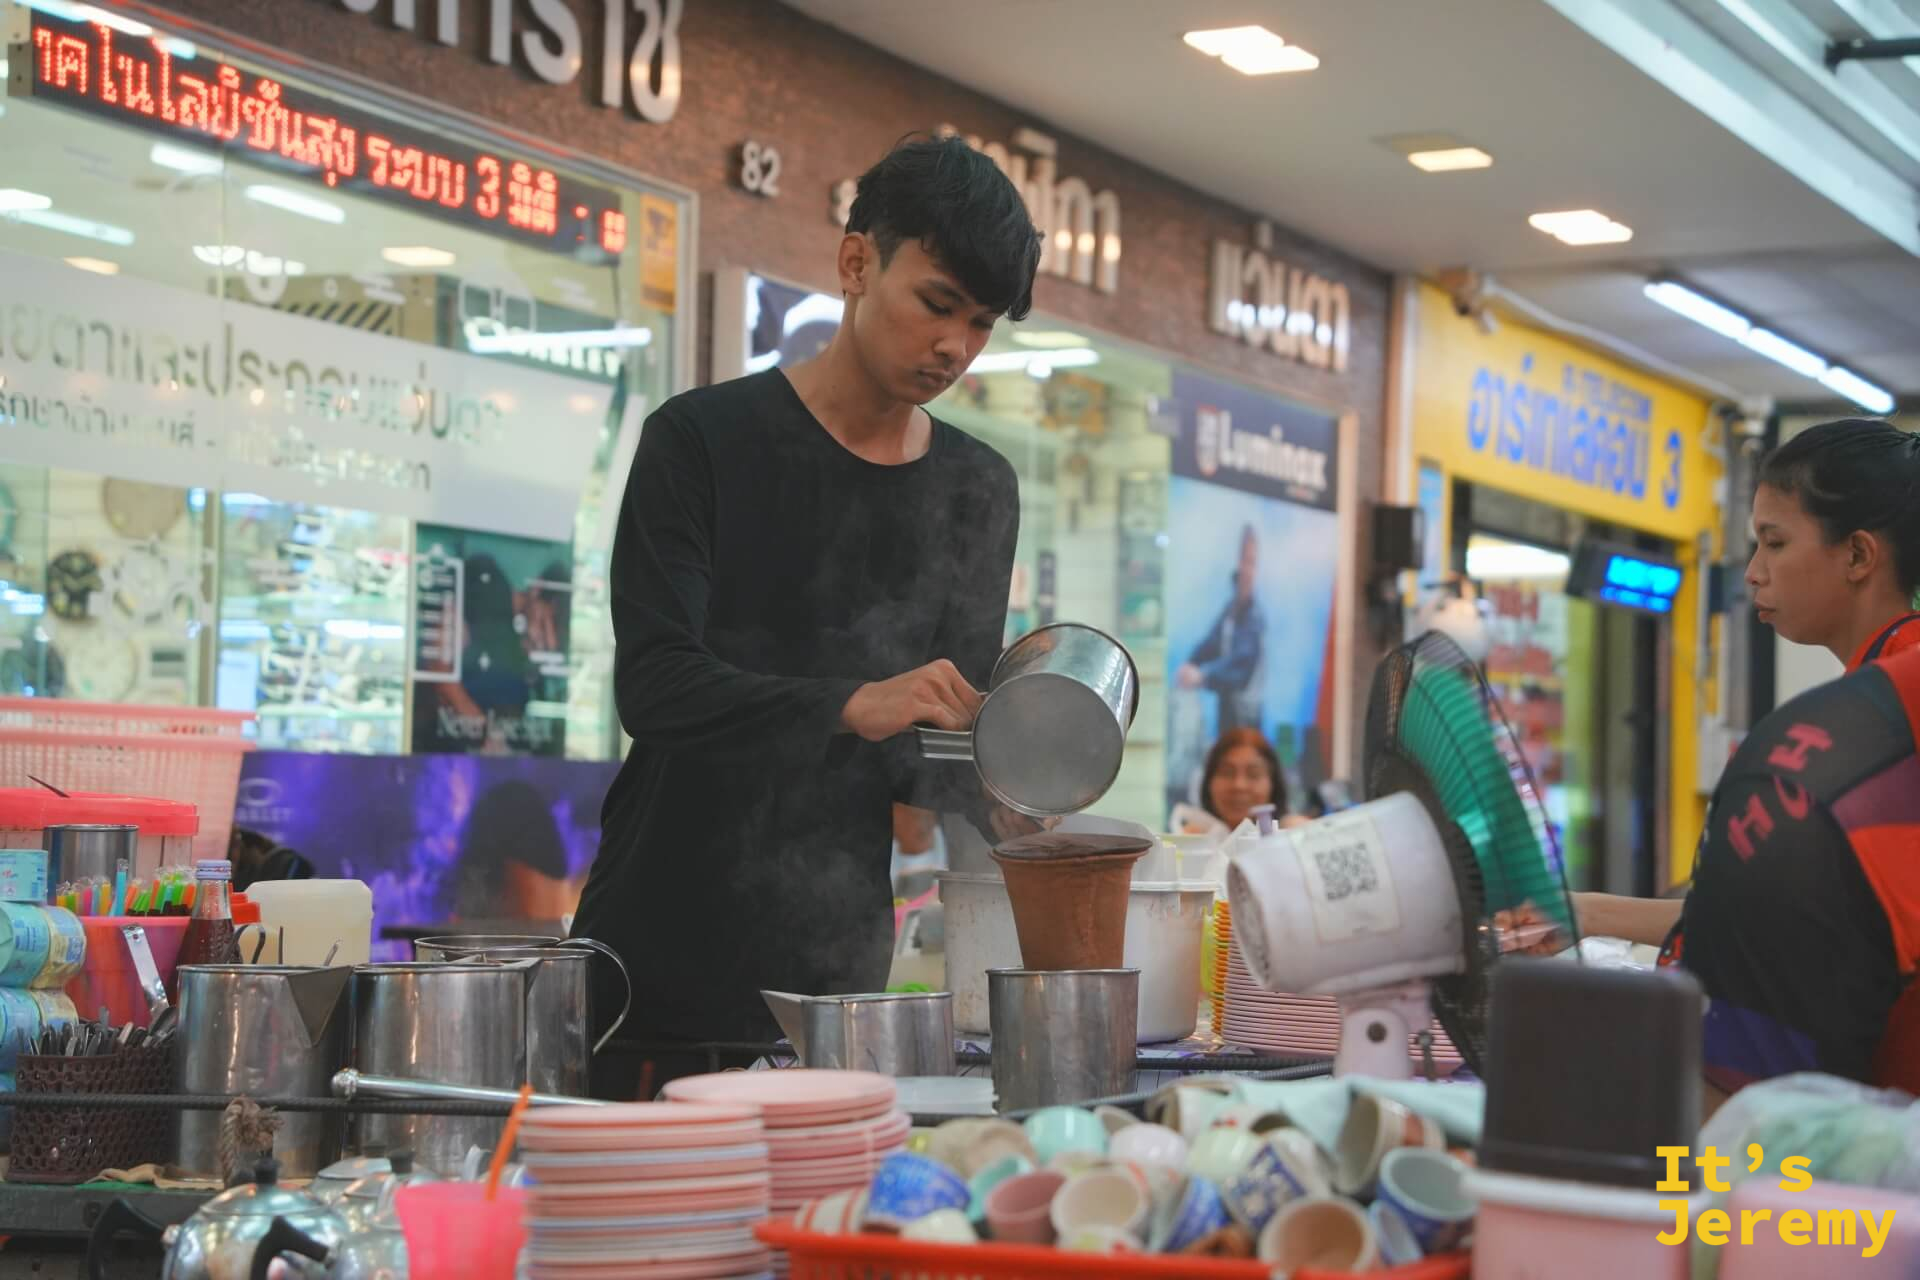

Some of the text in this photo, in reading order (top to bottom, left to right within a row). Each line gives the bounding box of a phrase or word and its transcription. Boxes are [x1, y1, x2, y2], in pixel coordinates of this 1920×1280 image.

[366, 134, 466, 209] ระบบ
[475, 155, 501, 219] 3
[741, 139, 783, 196] 82
[1210, 221, 1350, 374] แว่นตา
[1661, 427, 1685, 511] 3
